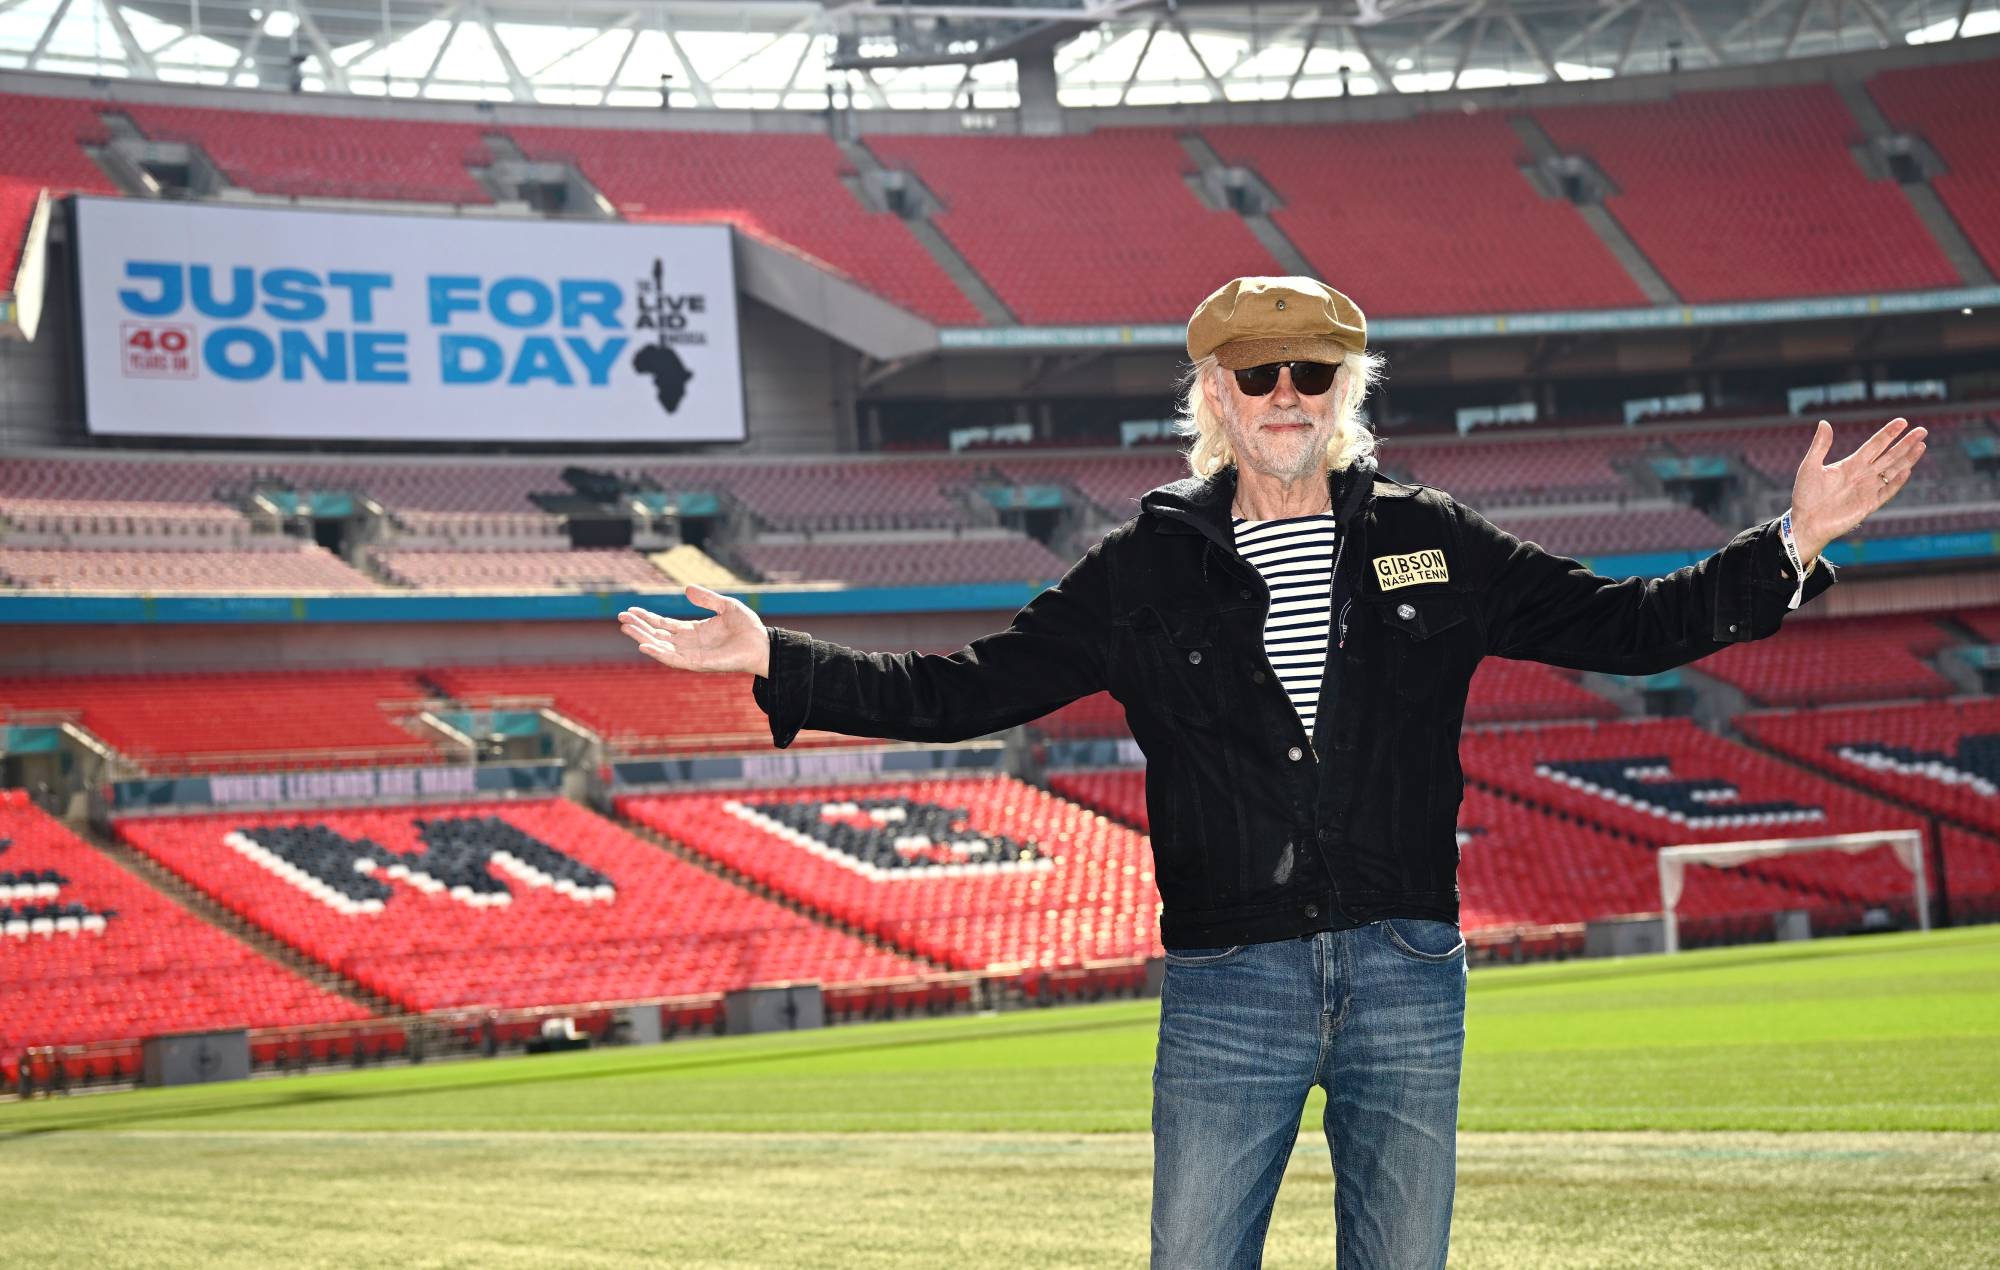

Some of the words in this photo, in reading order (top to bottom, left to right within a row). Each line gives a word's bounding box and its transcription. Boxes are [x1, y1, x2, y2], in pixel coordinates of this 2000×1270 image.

[118, 260, 394, 325] JUST
[426, 274, 625, 330] FOR
[637, 293, 705, 314] LIVE
[635, 313, 688, 330] AID
[129, 329, 188, 353] 40
[202, 325, 411, 385] ONE
[438, 332, 630, 388] DAY
[1378, 551, 1444, 576] GIBSON
[1382, 573, 1415, 587] NASH
[1416, 569, 1447, 581] TENN
